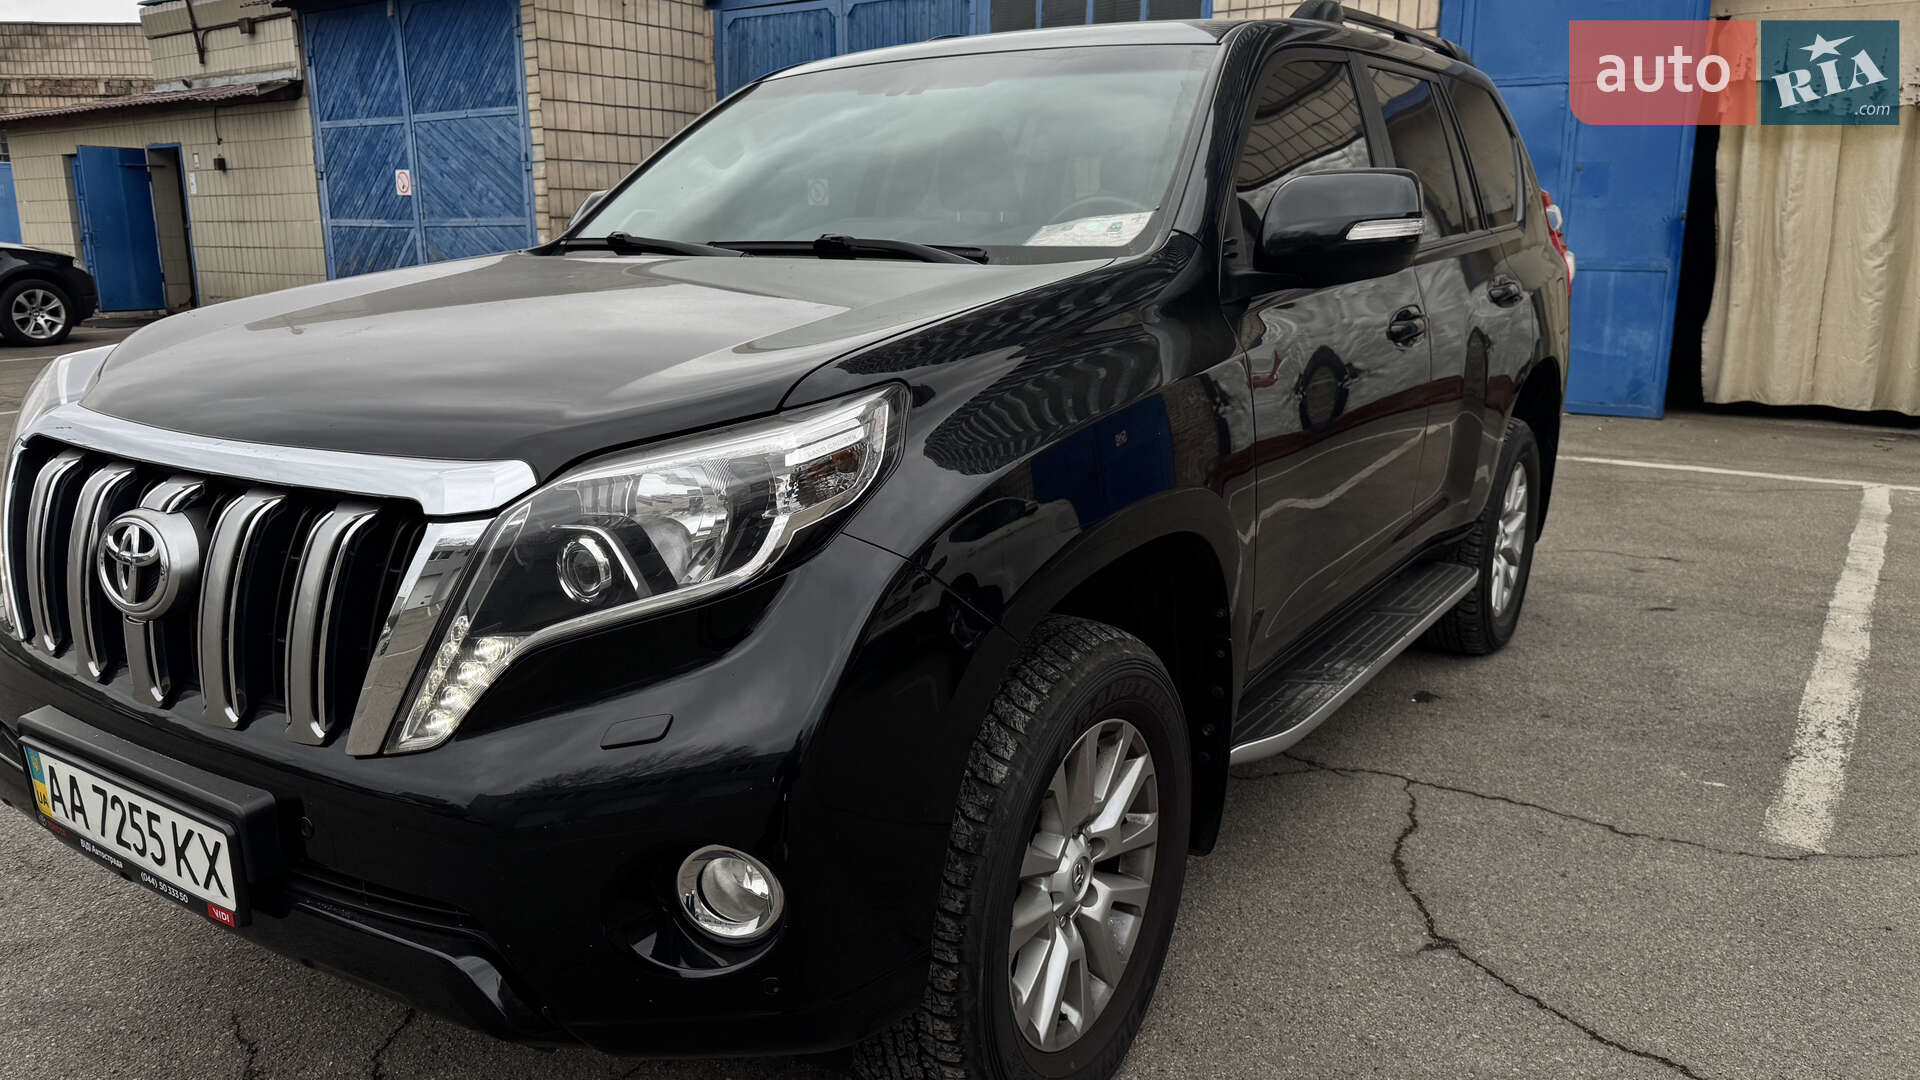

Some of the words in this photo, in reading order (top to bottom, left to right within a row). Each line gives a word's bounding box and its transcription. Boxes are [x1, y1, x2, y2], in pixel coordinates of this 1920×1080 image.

[36, 791, 49, 808] UA
[140, 871, 158, 889] (044)
[212, 907, 230, 923] VIDI
